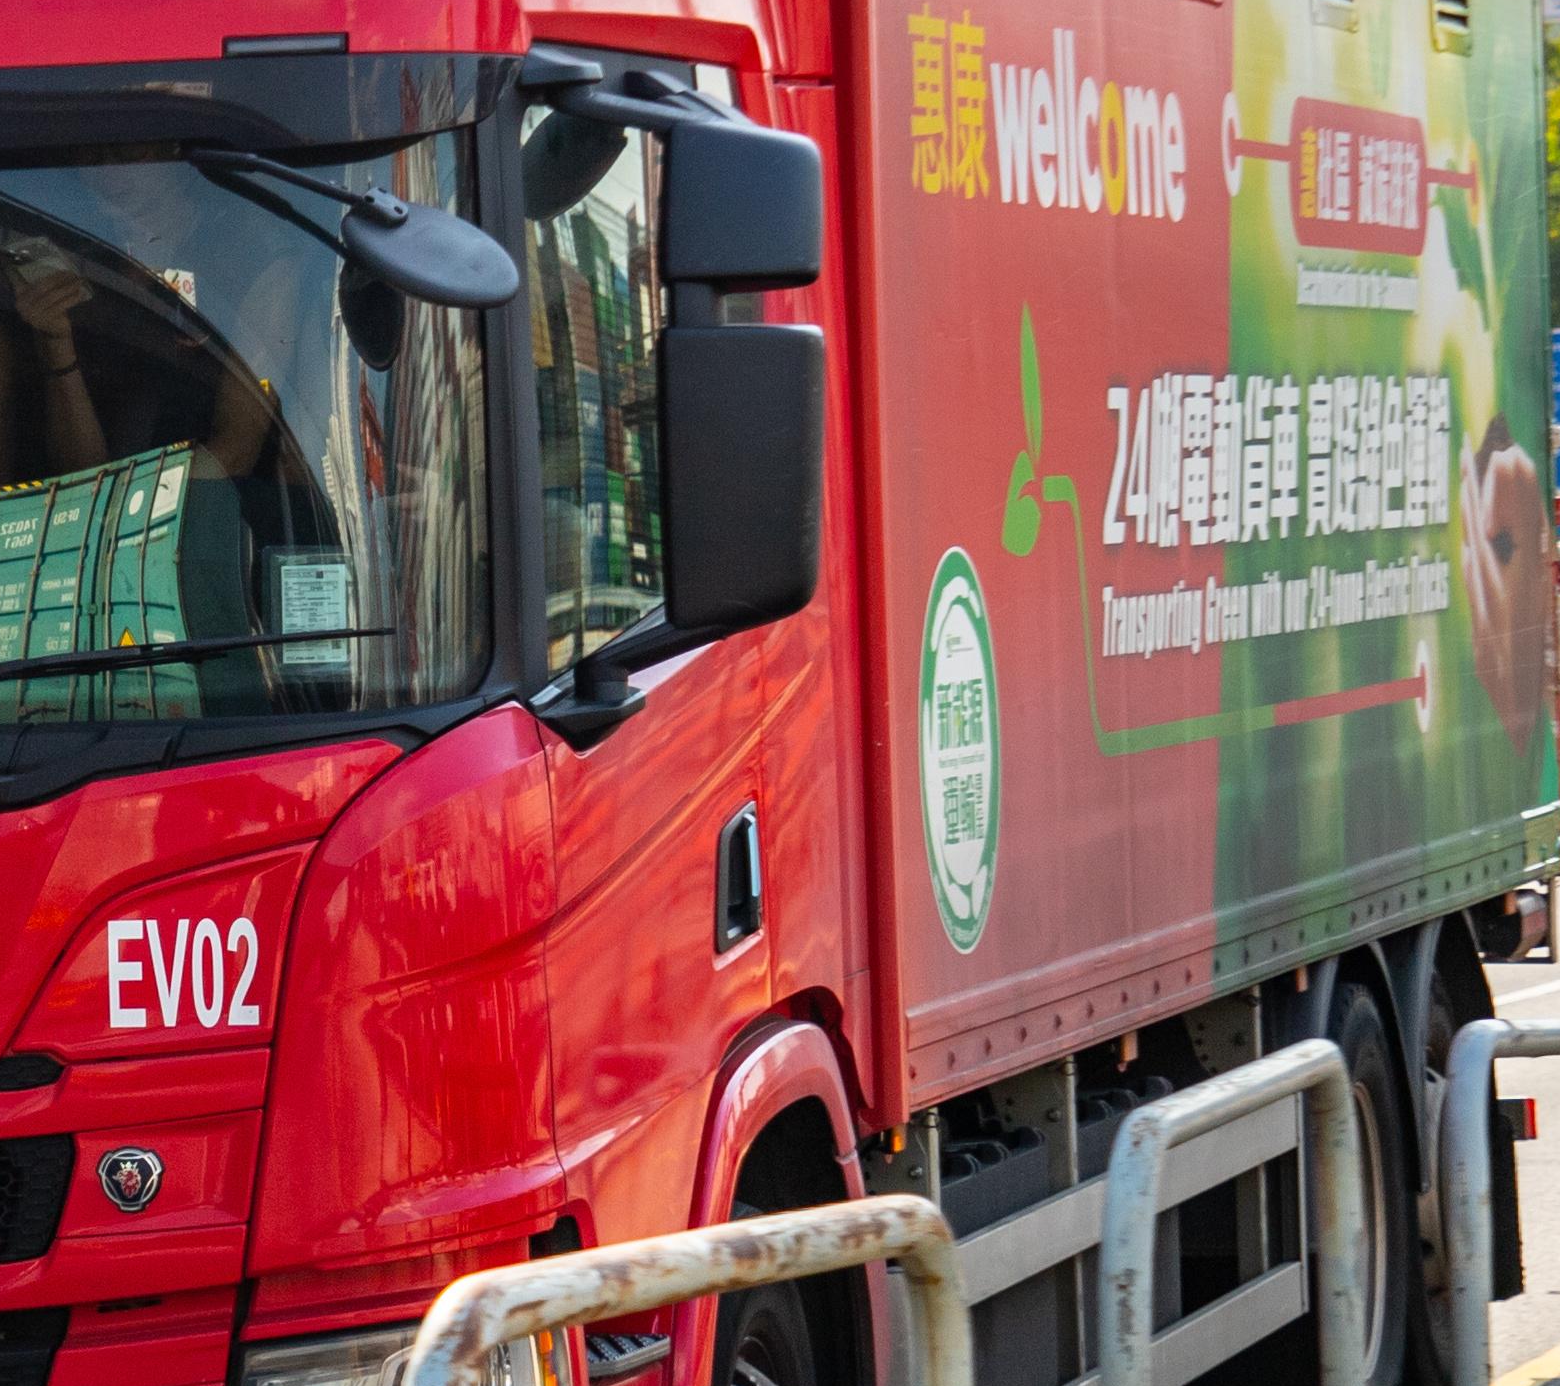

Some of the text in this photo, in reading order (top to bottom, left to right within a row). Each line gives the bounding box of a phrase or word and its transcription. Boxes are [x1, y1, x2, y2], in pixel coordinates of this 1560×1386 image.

[908, 3, 990, 199] 惠康
[990, 28, 1187, 223] wellcome
[1102, 579, 1203, 659] Transporting
[1205, 575, 1249, 645] Green
[1250, 571, 1284, 636] with
[1285, 578, 1309, 633] our
[107, 917, 261, 1028] EV02
